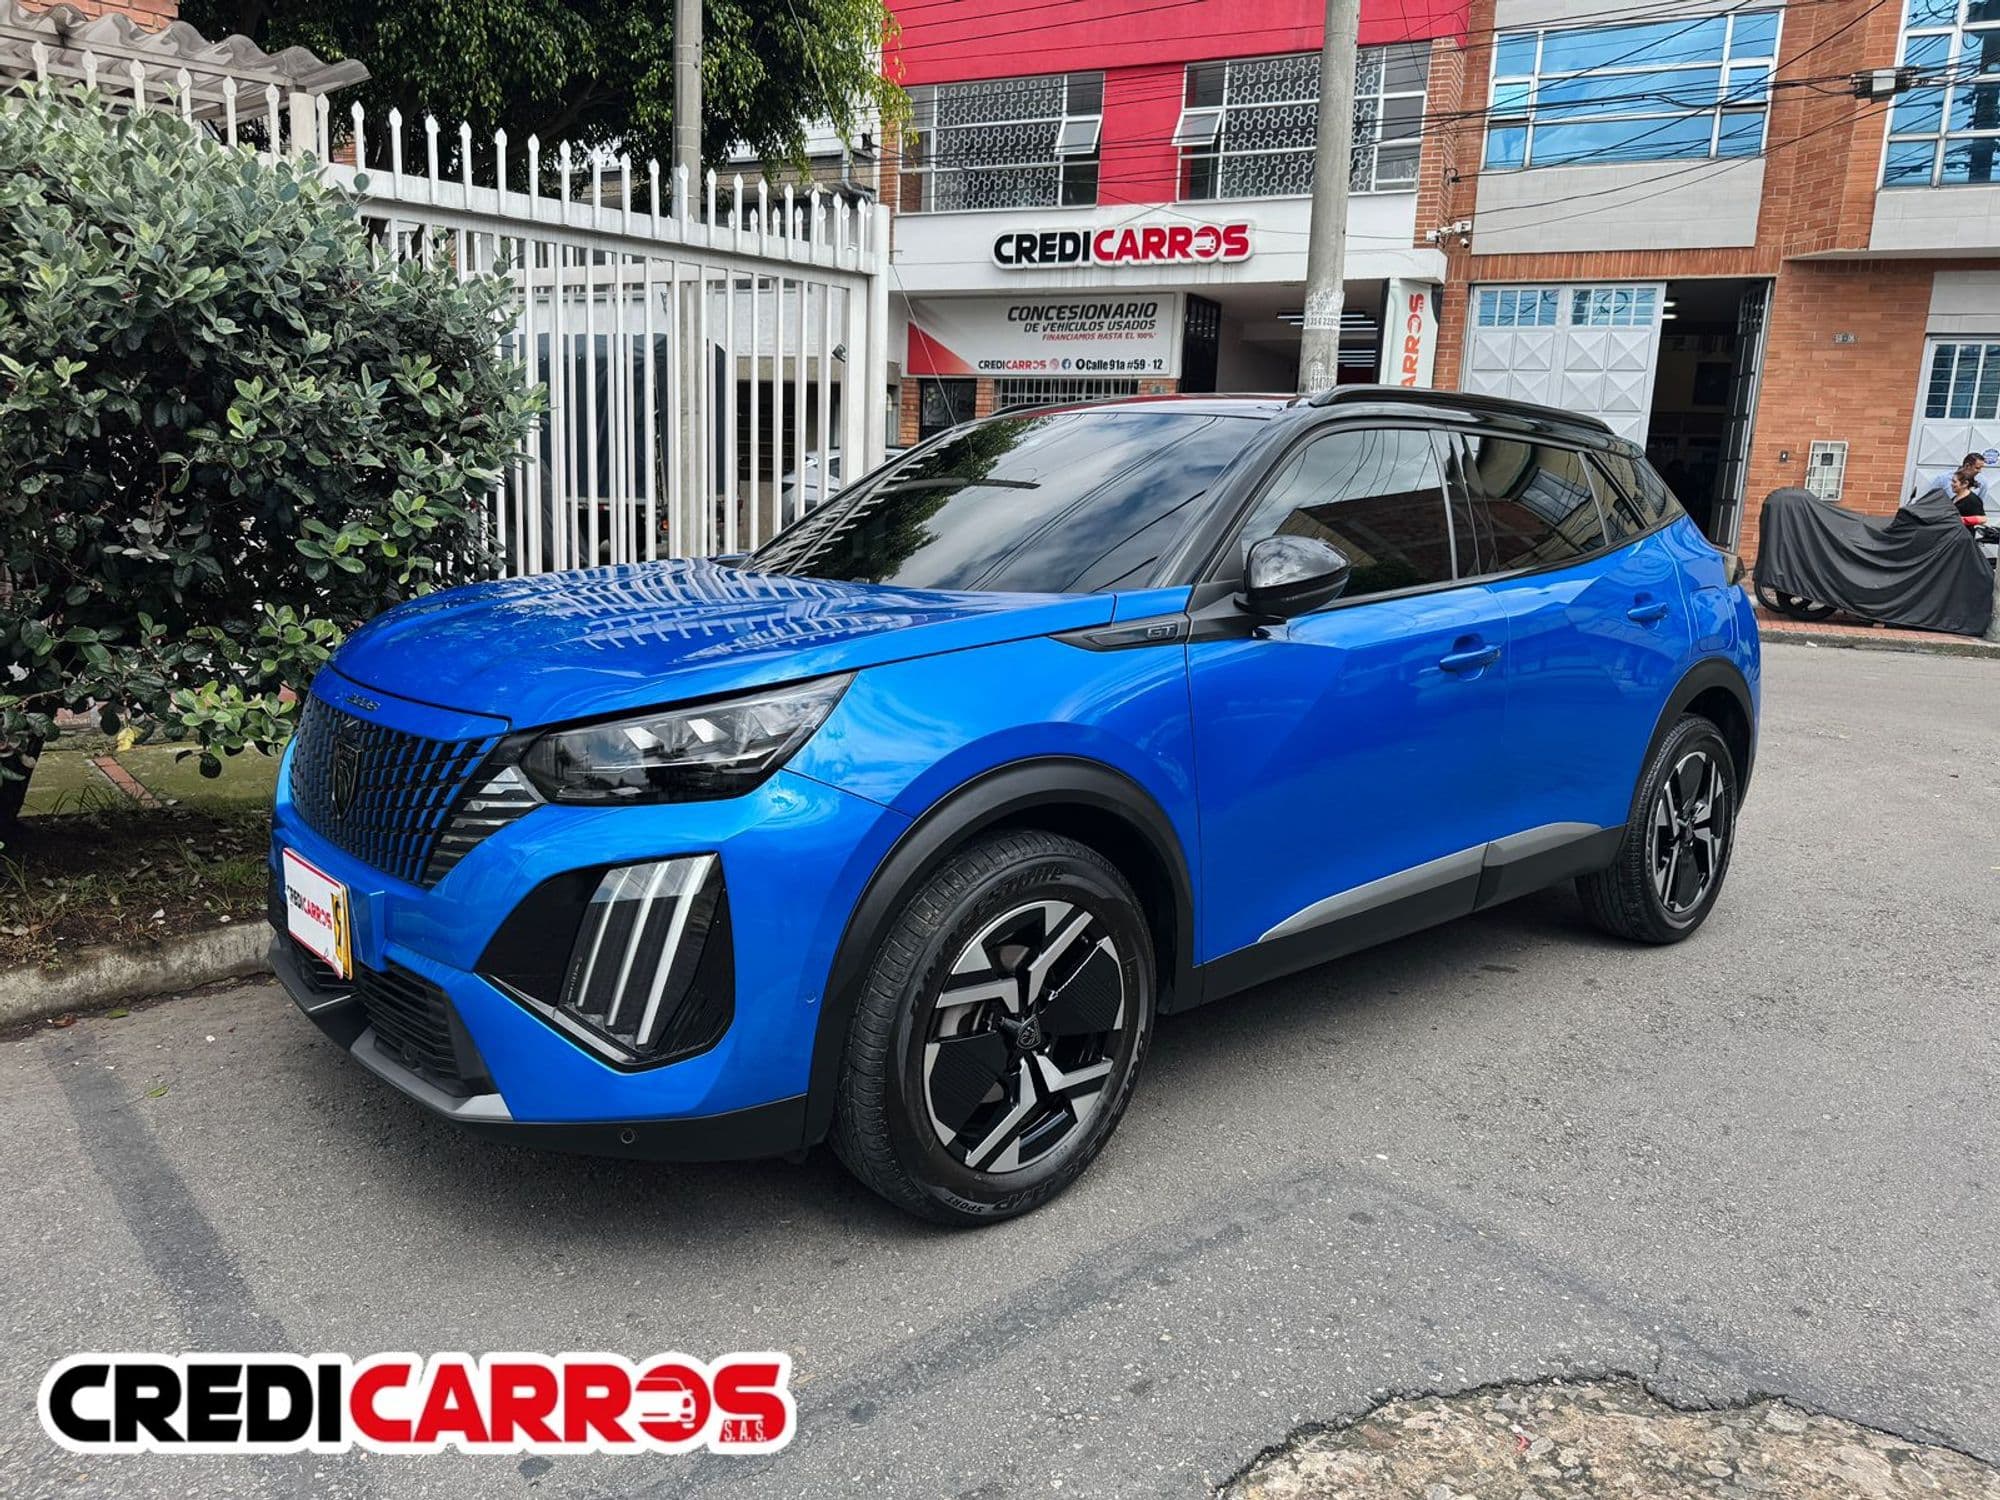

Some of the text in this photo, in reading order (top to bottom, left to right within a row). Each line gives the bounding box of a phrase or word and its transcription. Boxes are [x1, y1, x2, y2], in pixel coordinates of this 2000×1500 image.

[993, 224, 1248, 264] CREDICARROS
[1007, 302, 1158, 321] CONCESIONARIO
[1024, 319, 1157, 333] DE VEHÍCULOS USADOS
[1042, 332, 1097, 342] FINANCIAMOS
[1097, 332, 1123, 340] HASTA
[1124, 332, 1135, 340] EL
[978, 359, 1046, 370] CREDICARROS
[1086, 359, 1109, 370] Calle
[1109, 359, 1125, 370] 91a
[1126, 359, 1146, 370] #59
[1152, 358, 1164, 370] 12
[1148, 625, 1176, 639] GT
[944, 1195, 985, 1213] SPORT
